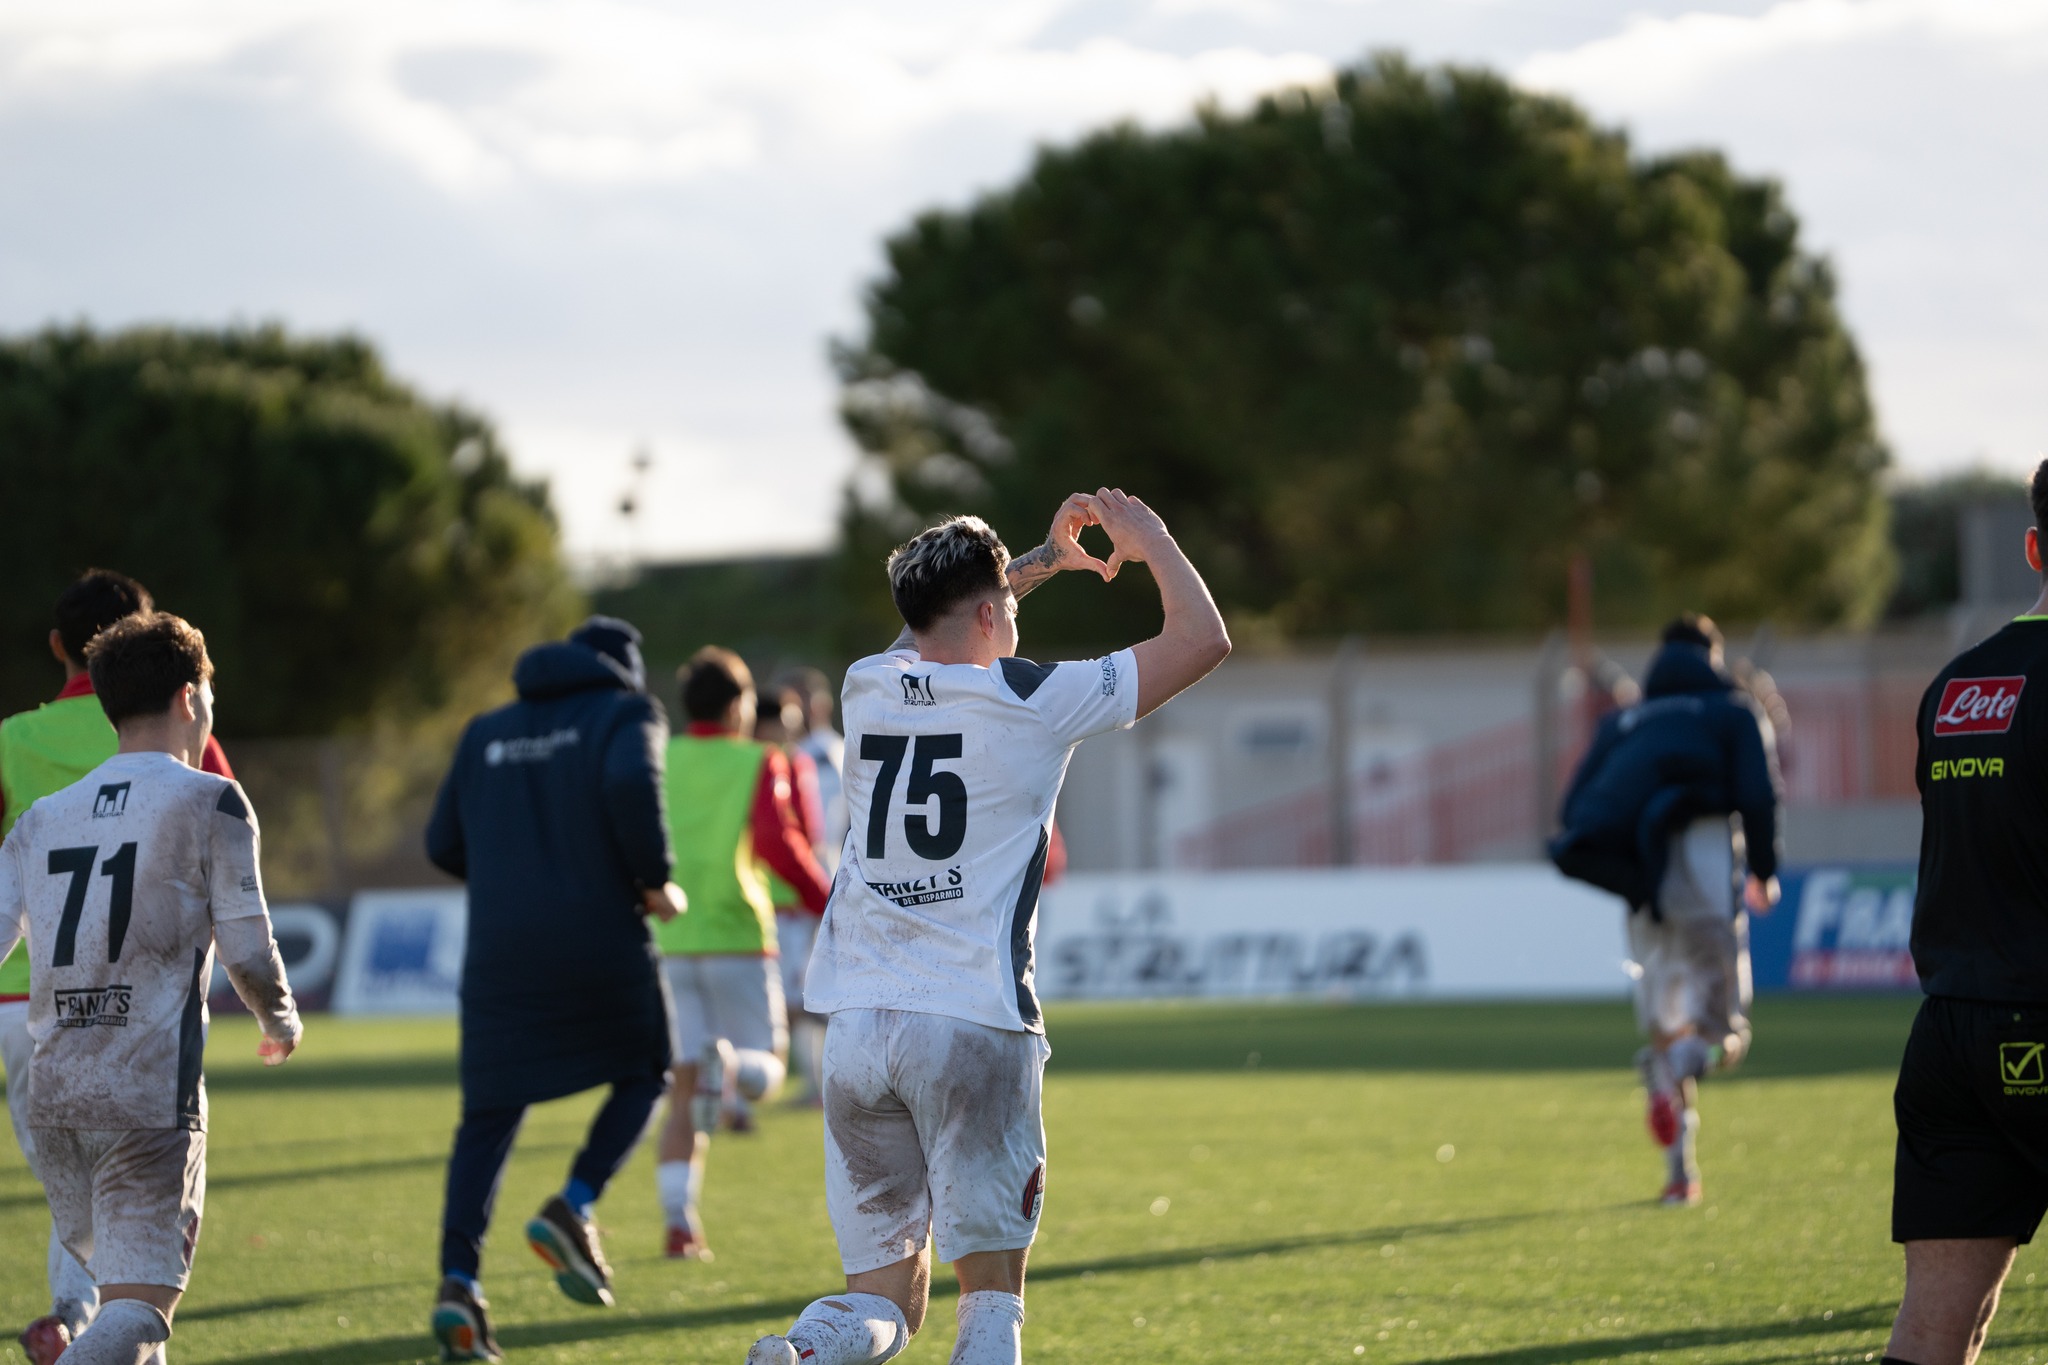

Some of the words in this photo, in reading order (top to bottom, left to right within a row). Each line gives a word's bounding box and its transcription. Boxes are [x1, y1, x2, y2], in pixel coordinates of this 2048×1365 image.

[1938, 685, 2016, 725] Lete
[1931, 757, 2004, 781] GIVOVA
[860, 733, 967, 861] 75
[48, 842, 138, 967] 71
[903, 897, 916, 906] DEL
[919, 889, 961, 903] RISPARMIO
